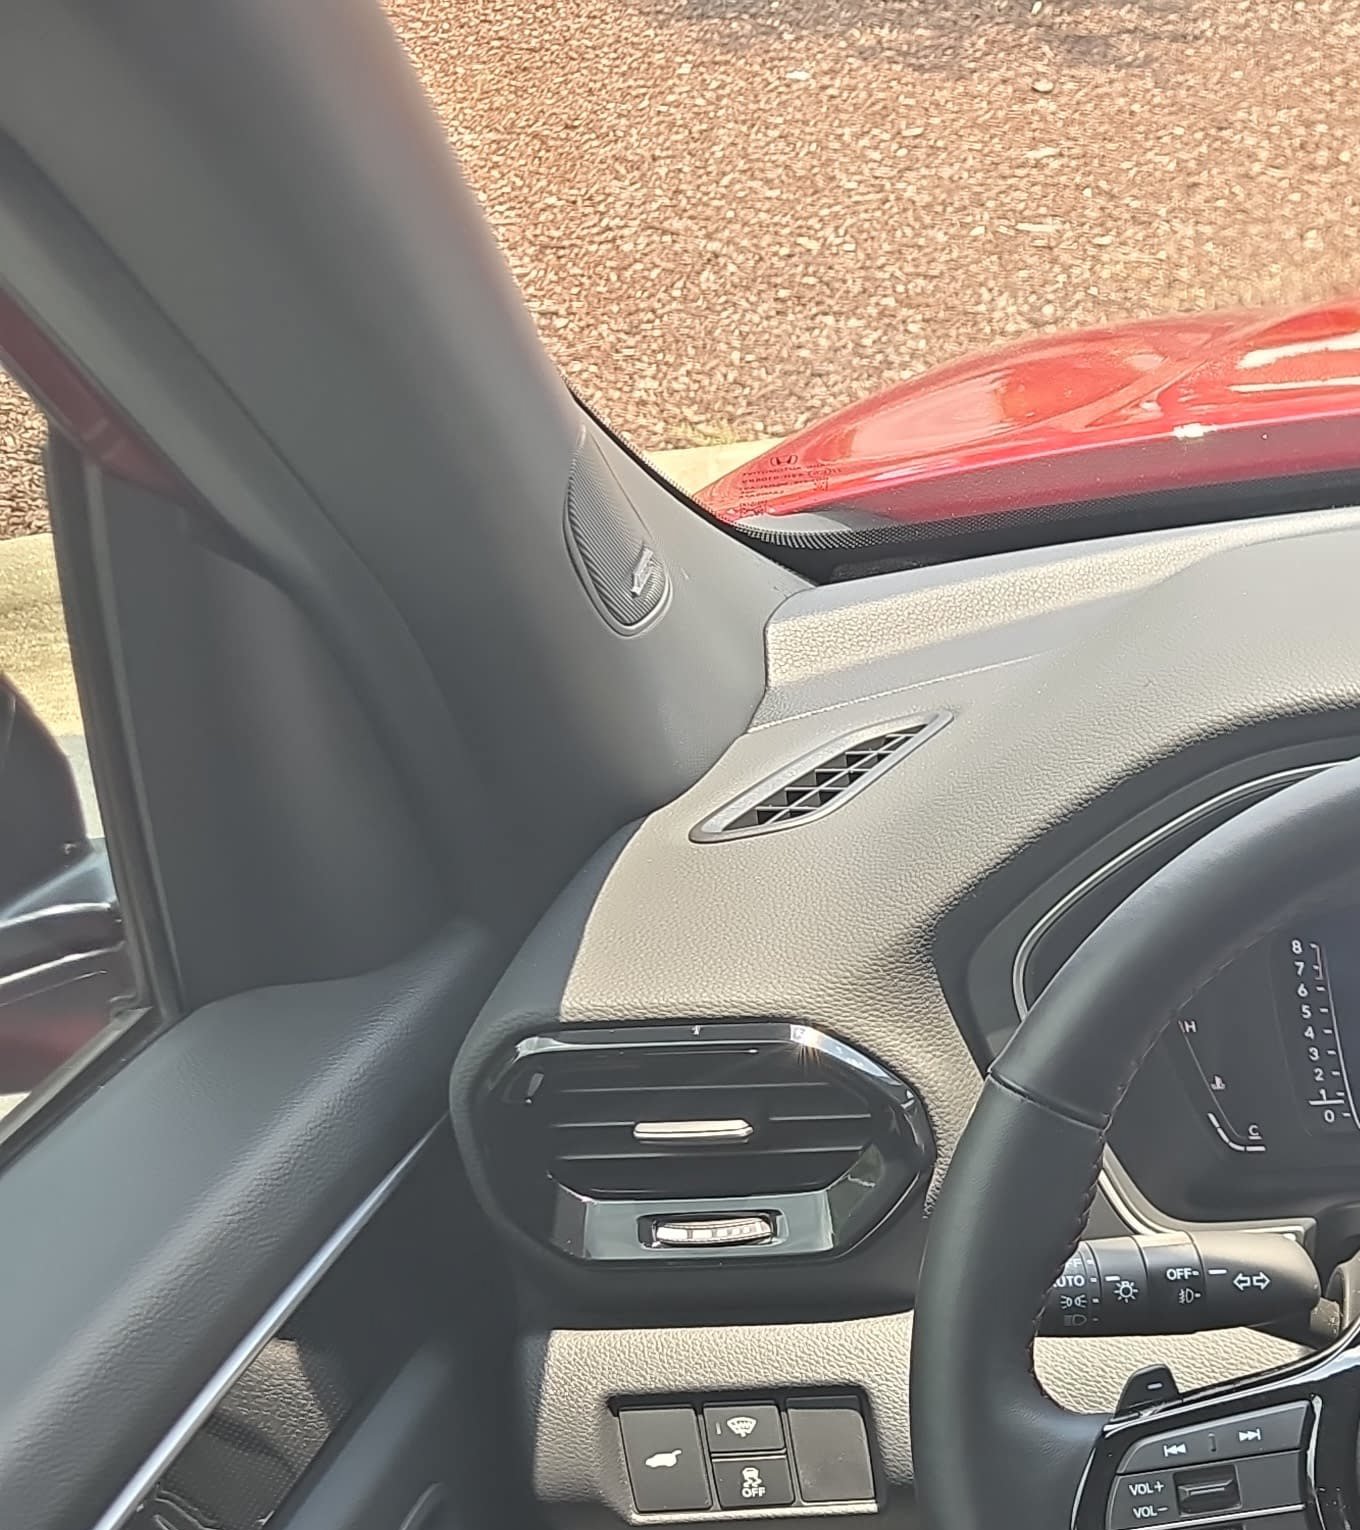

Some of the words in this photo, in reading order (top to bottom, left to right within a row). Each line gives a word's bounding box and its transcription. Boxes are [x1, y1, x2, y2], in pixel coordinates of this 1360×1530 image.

[1291, 939, 1303, 954] 8
[1294, 961, 1305, 975] 7
[1297, 983, 1309, 998] 6
[1301, 1004, 1312, 1019] 5
[1303, 1026, 1316, 1040] 4
[1308, 1047, 1320, 1061] 3
[1314, 1068, 1325, 1082] 2
[1324, 1108, 1336, 1123] 0
[1248, 1123, 1259, 1137] C
[1166, 1268, 1192, 1280] OFF
[1053, 1275, 1085, 1288] UTO
[741, 1486, 766, 1498] OFF
